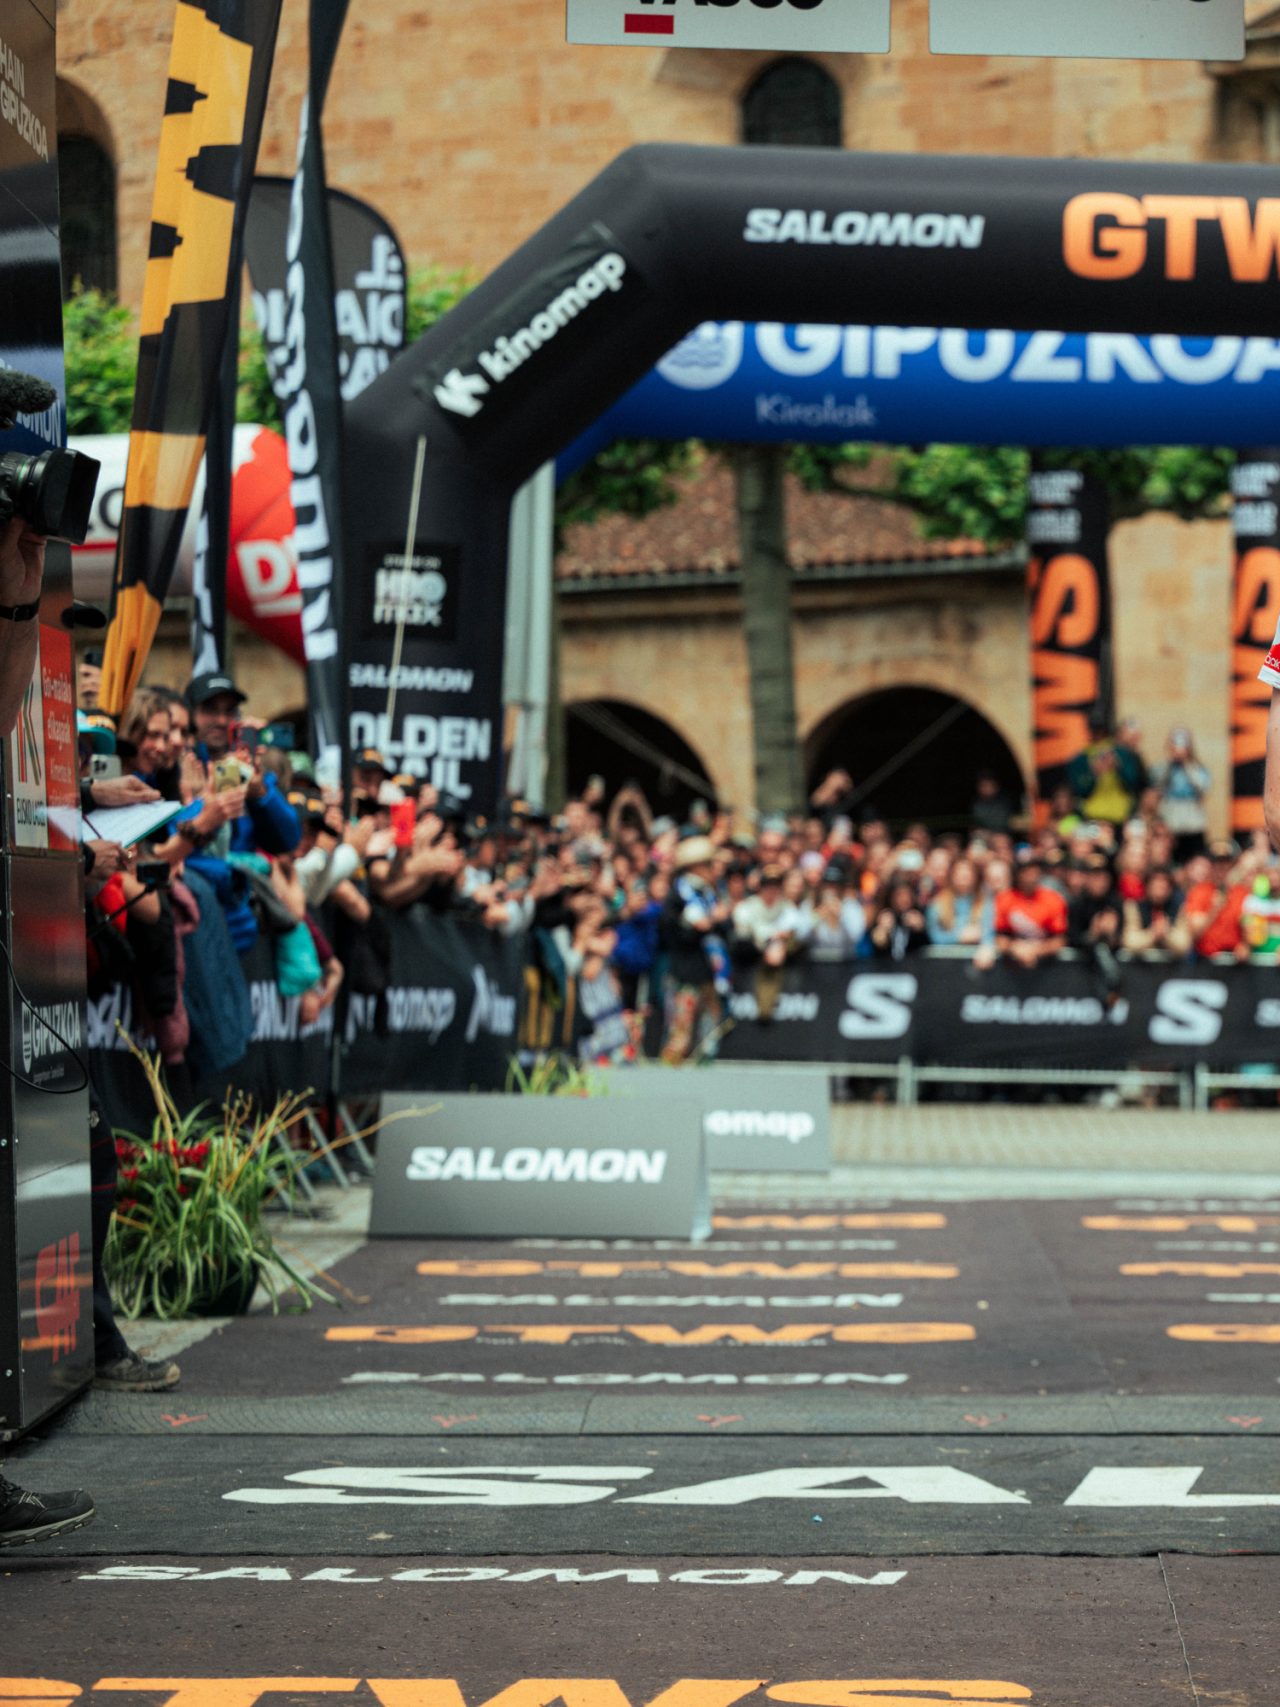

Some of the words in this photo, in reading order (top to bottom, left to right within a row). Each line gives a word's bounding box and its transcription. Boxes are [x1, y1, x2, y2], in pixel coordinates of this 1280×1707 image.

[1, 80, 49, 163] GIPUZKOA
[742, 208, 986, 249] SALOMON
[477, 252, 626, 383] kinomap
[756, 396, 875, 428] Kirolak
[837, 972, 919, 1040] S
[1147, 978, 1229, 1045] S
[703, 1109, 816, 1144] omap
[405, 1146, 668, 1183] SALOMON
[77, 1566, 909, 1586] SALOMON
